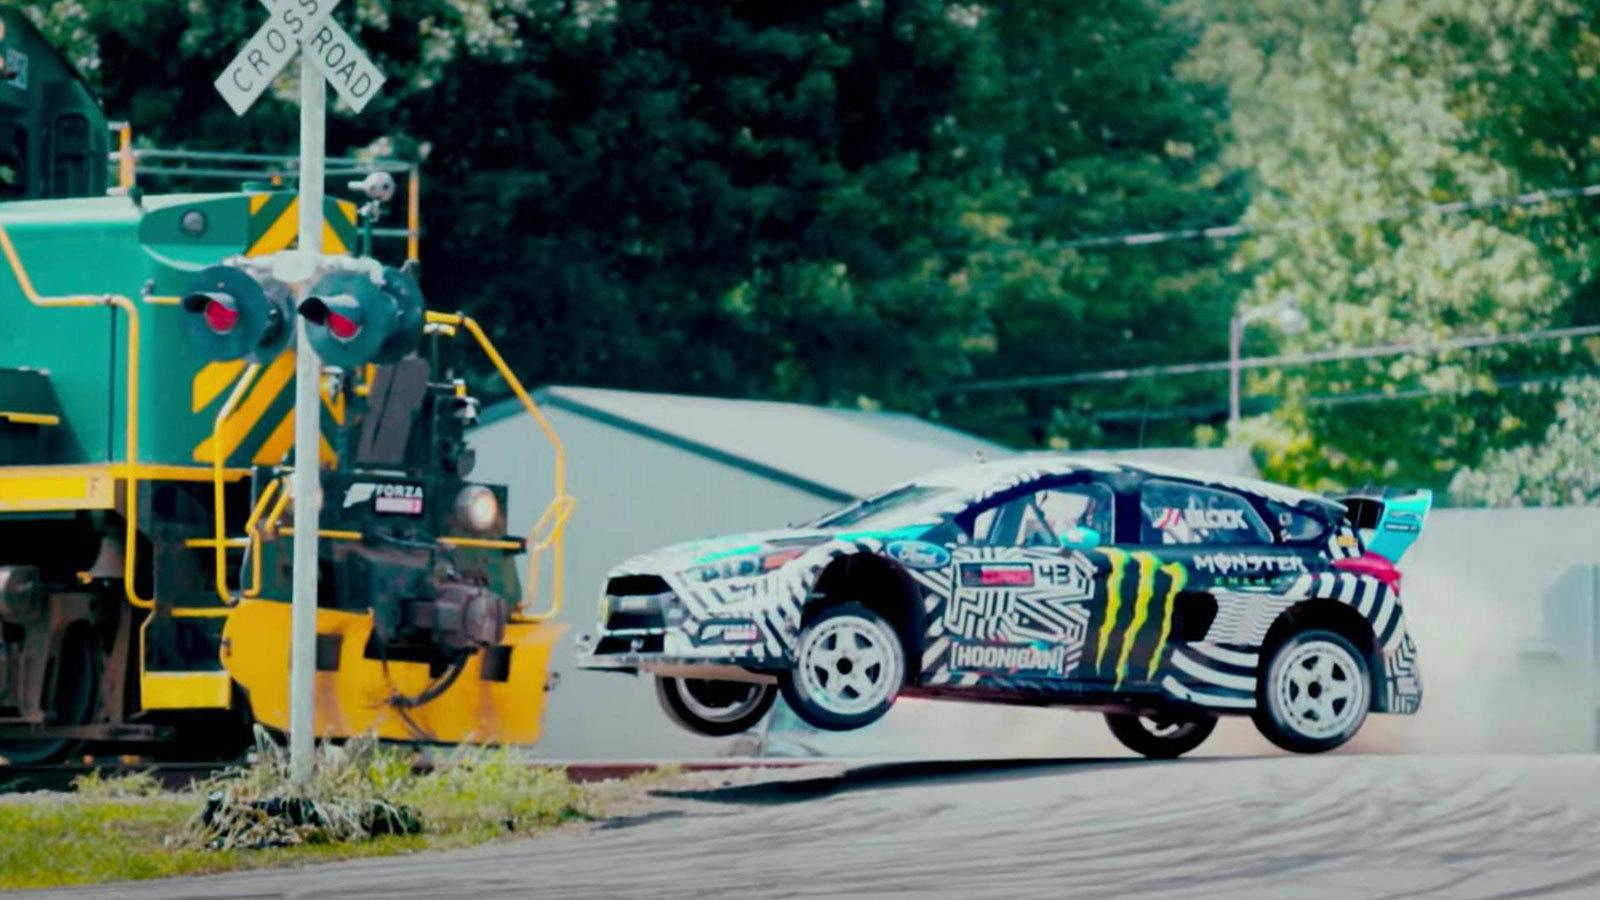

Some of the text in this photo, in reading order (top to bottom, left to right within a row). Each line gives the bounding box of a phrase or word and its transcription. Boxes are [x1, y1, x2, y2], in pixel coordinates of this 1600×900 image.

[311, 26, 371, 98] ROAD
[375, 484, 423, 498] FORZA
[1193, 553, 1309, 574] MONSTER
[1039, 564, 1071, 585] 43
